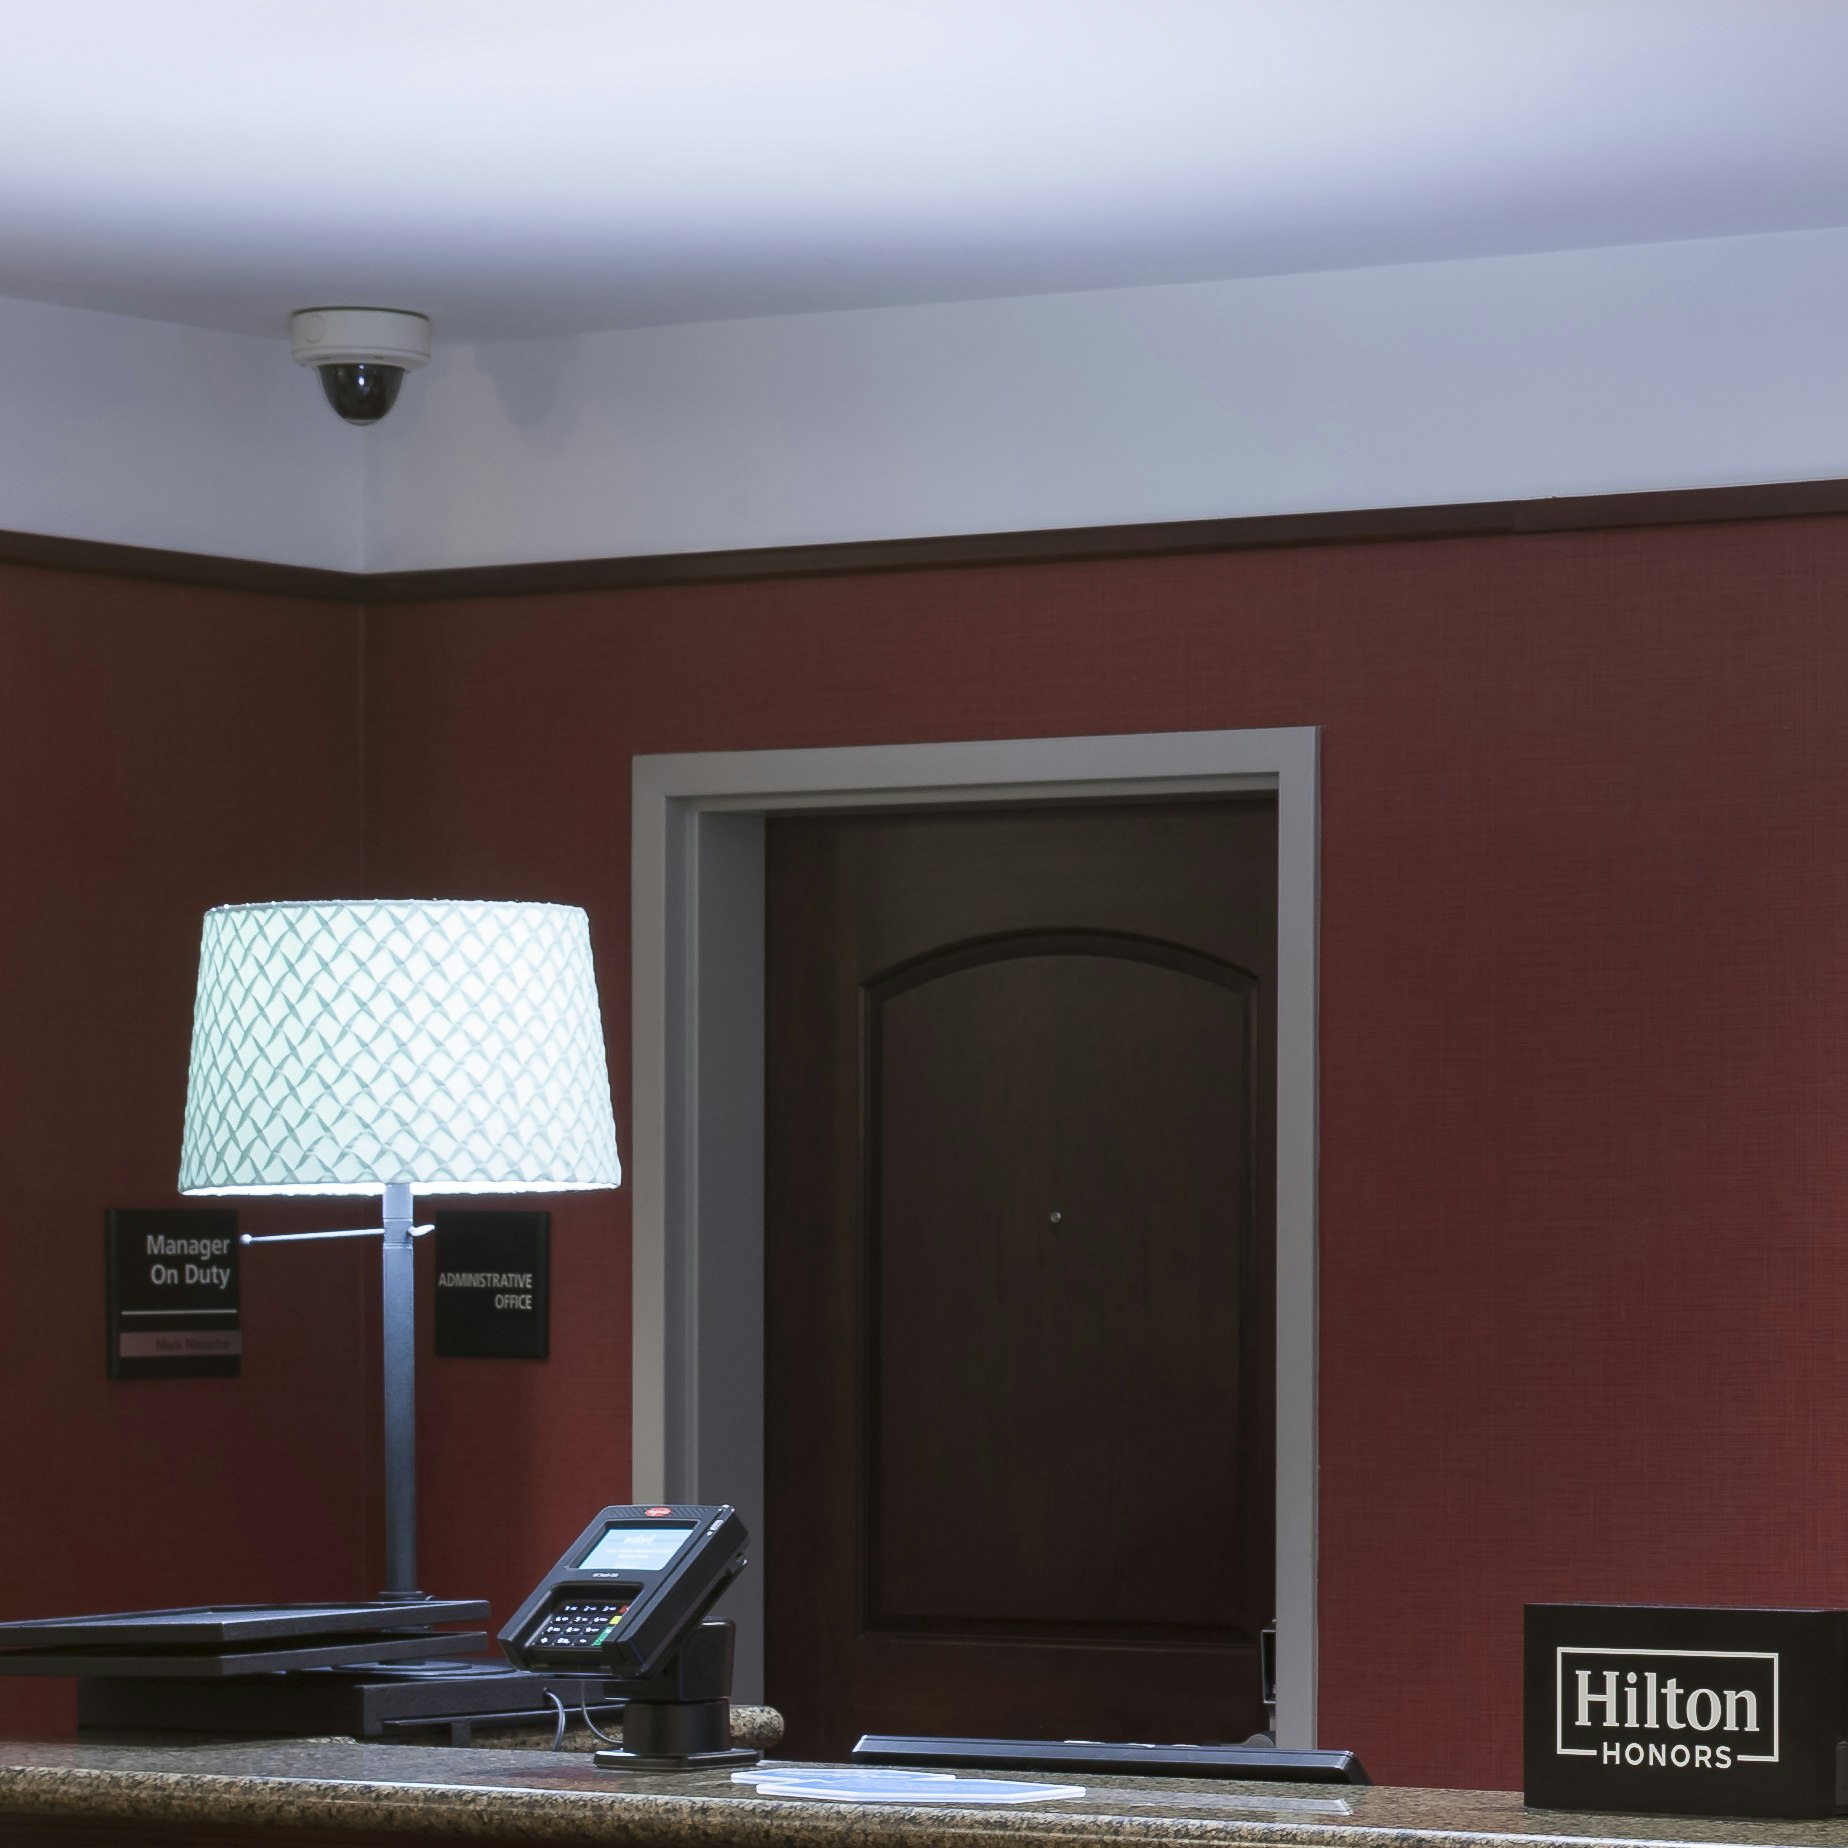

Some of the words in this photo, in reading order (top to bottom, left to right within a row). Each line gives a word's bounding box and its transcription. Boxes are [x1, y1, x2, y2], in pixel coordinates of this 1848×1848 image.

[146, 1233, 230, 1260] Manager
[150, 1263, 179, 1285] On
[185, 1263, 231, 1290] Duty
[438, 1272, 532, 1289] ADMINISTRATIVE
[494, 1294, 532, 1310] OFFICE
[1574, 1669, 1760, 1732] Hilton
[1602, 1741, 1732, 1769] HONORS
